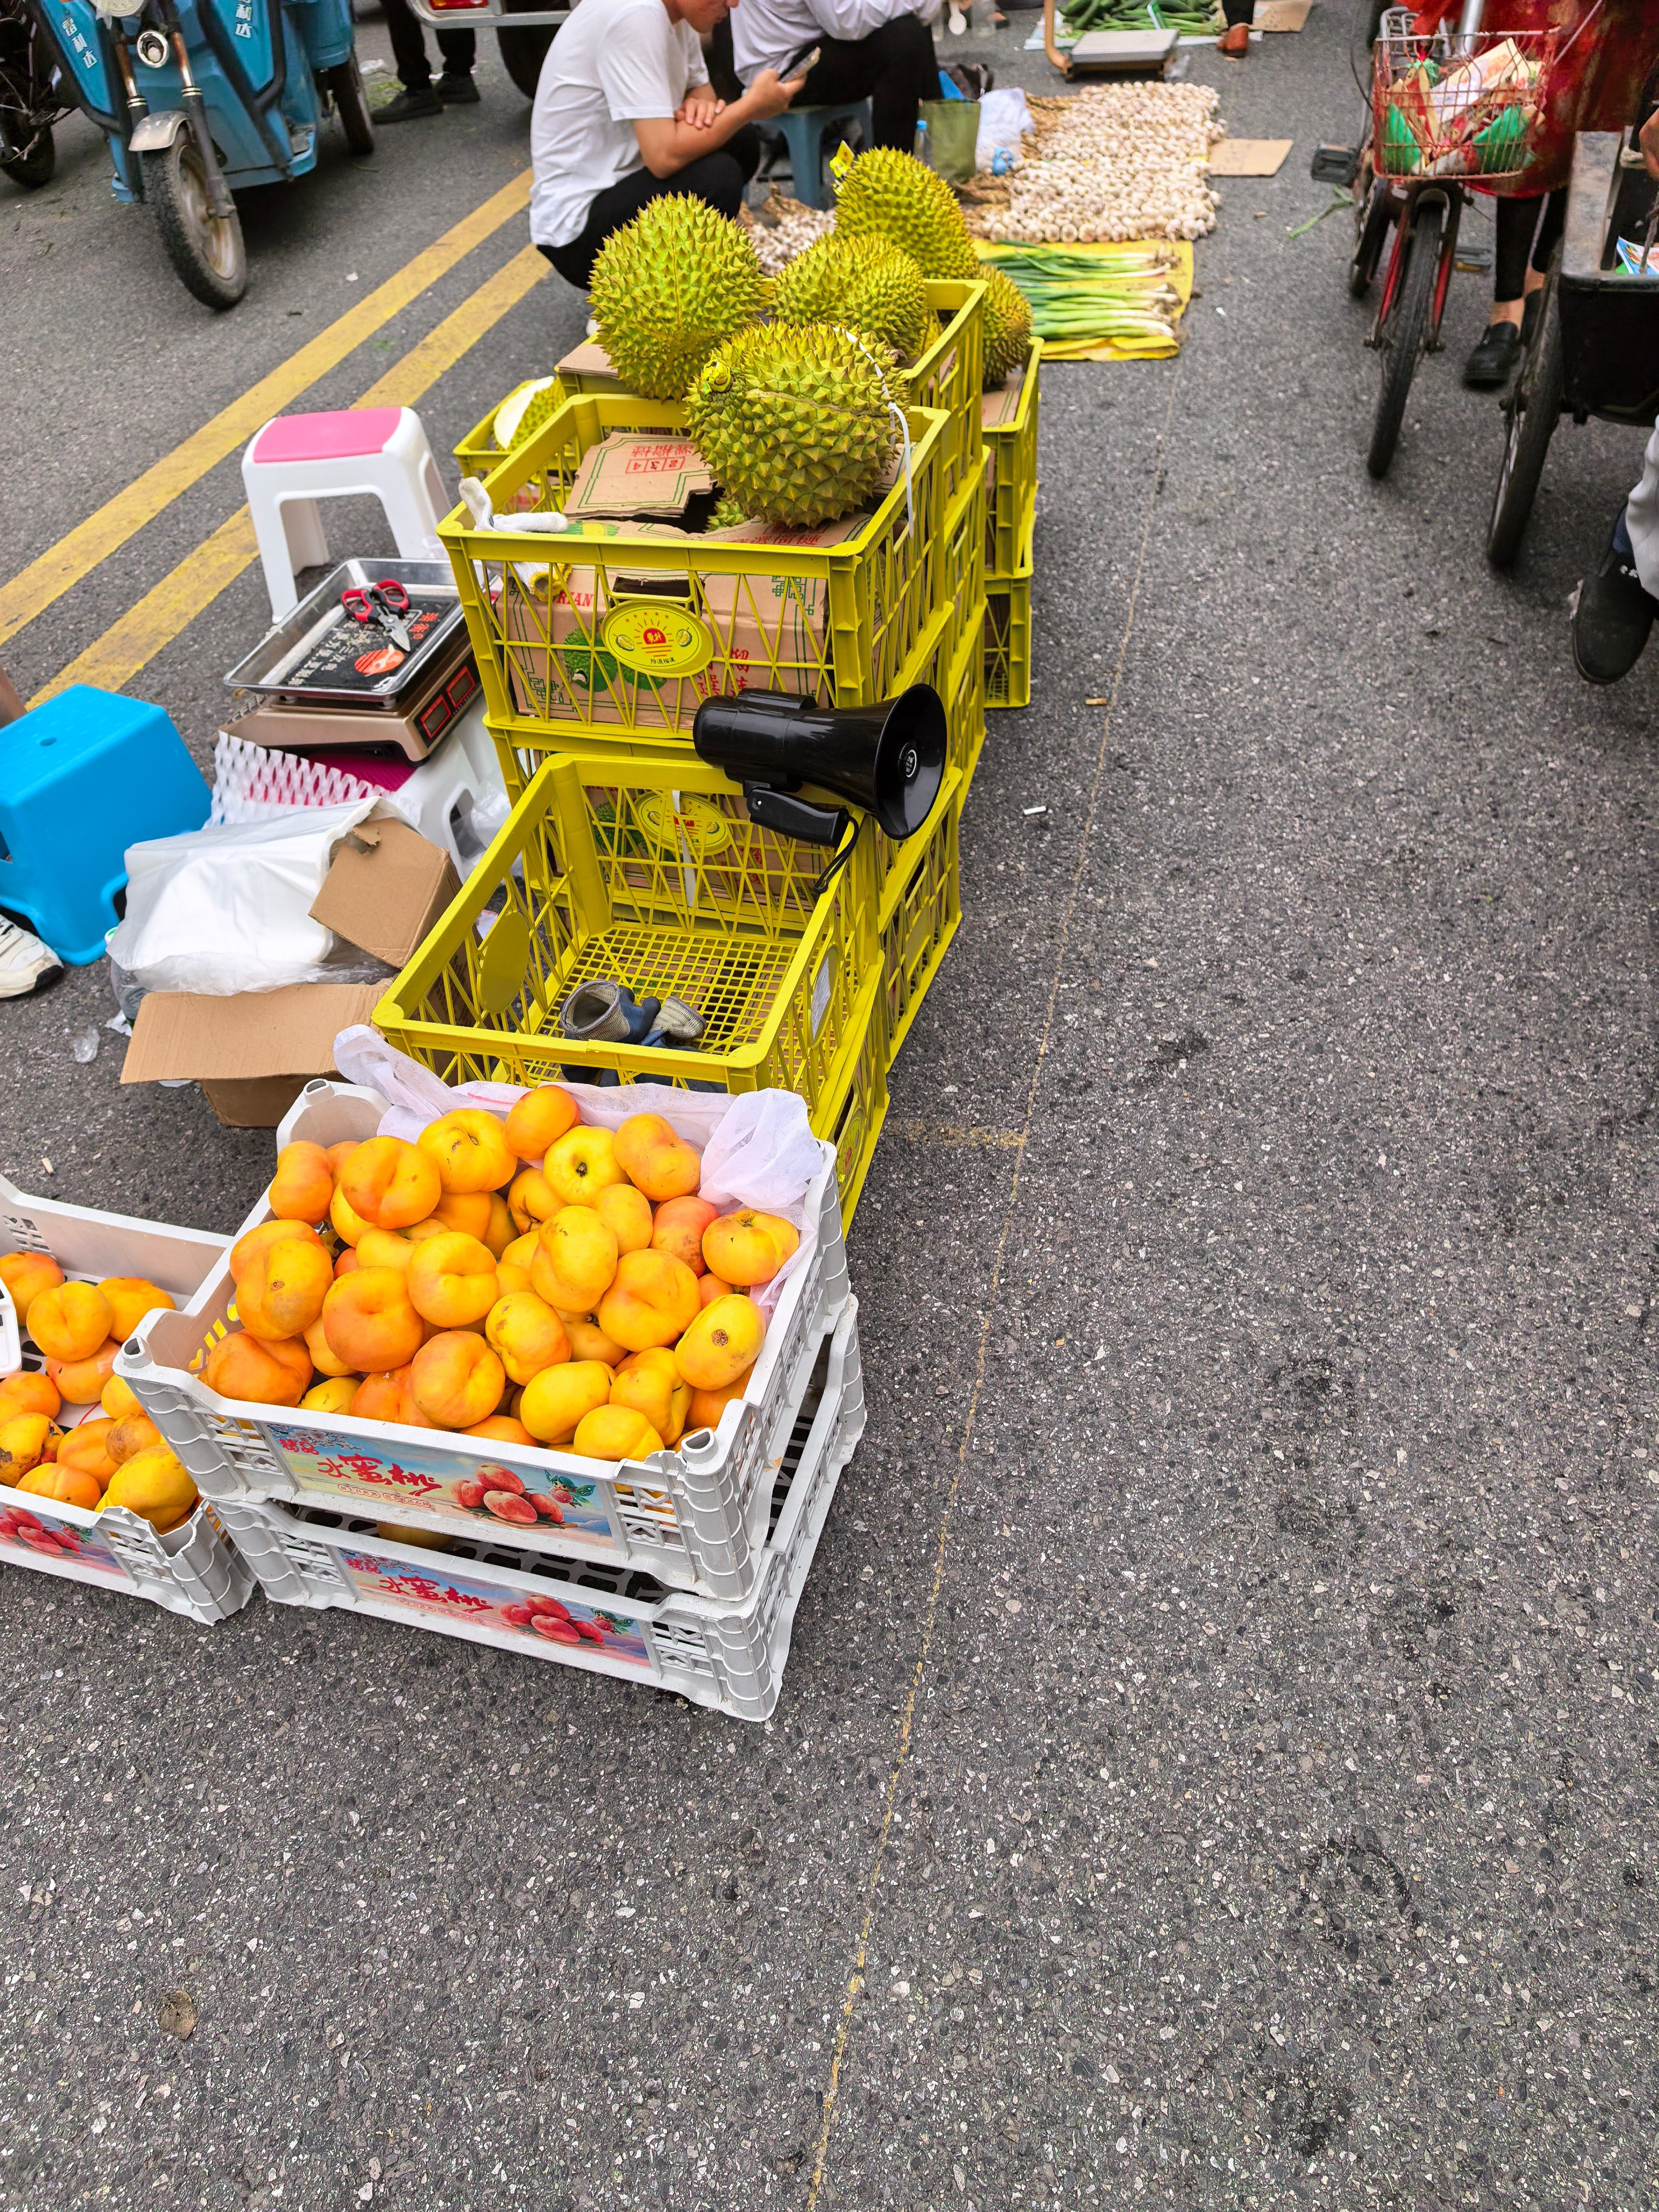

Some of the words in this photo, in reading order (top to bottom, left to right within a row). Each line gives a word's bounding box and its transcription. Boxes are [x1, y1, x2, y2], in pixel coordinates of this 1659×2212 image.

[235, 0, 252, 38] 利达
[317, 1453, 442, 1497] 水蜜桃
[379, 1574, 494, 1614] 水蜜桃
